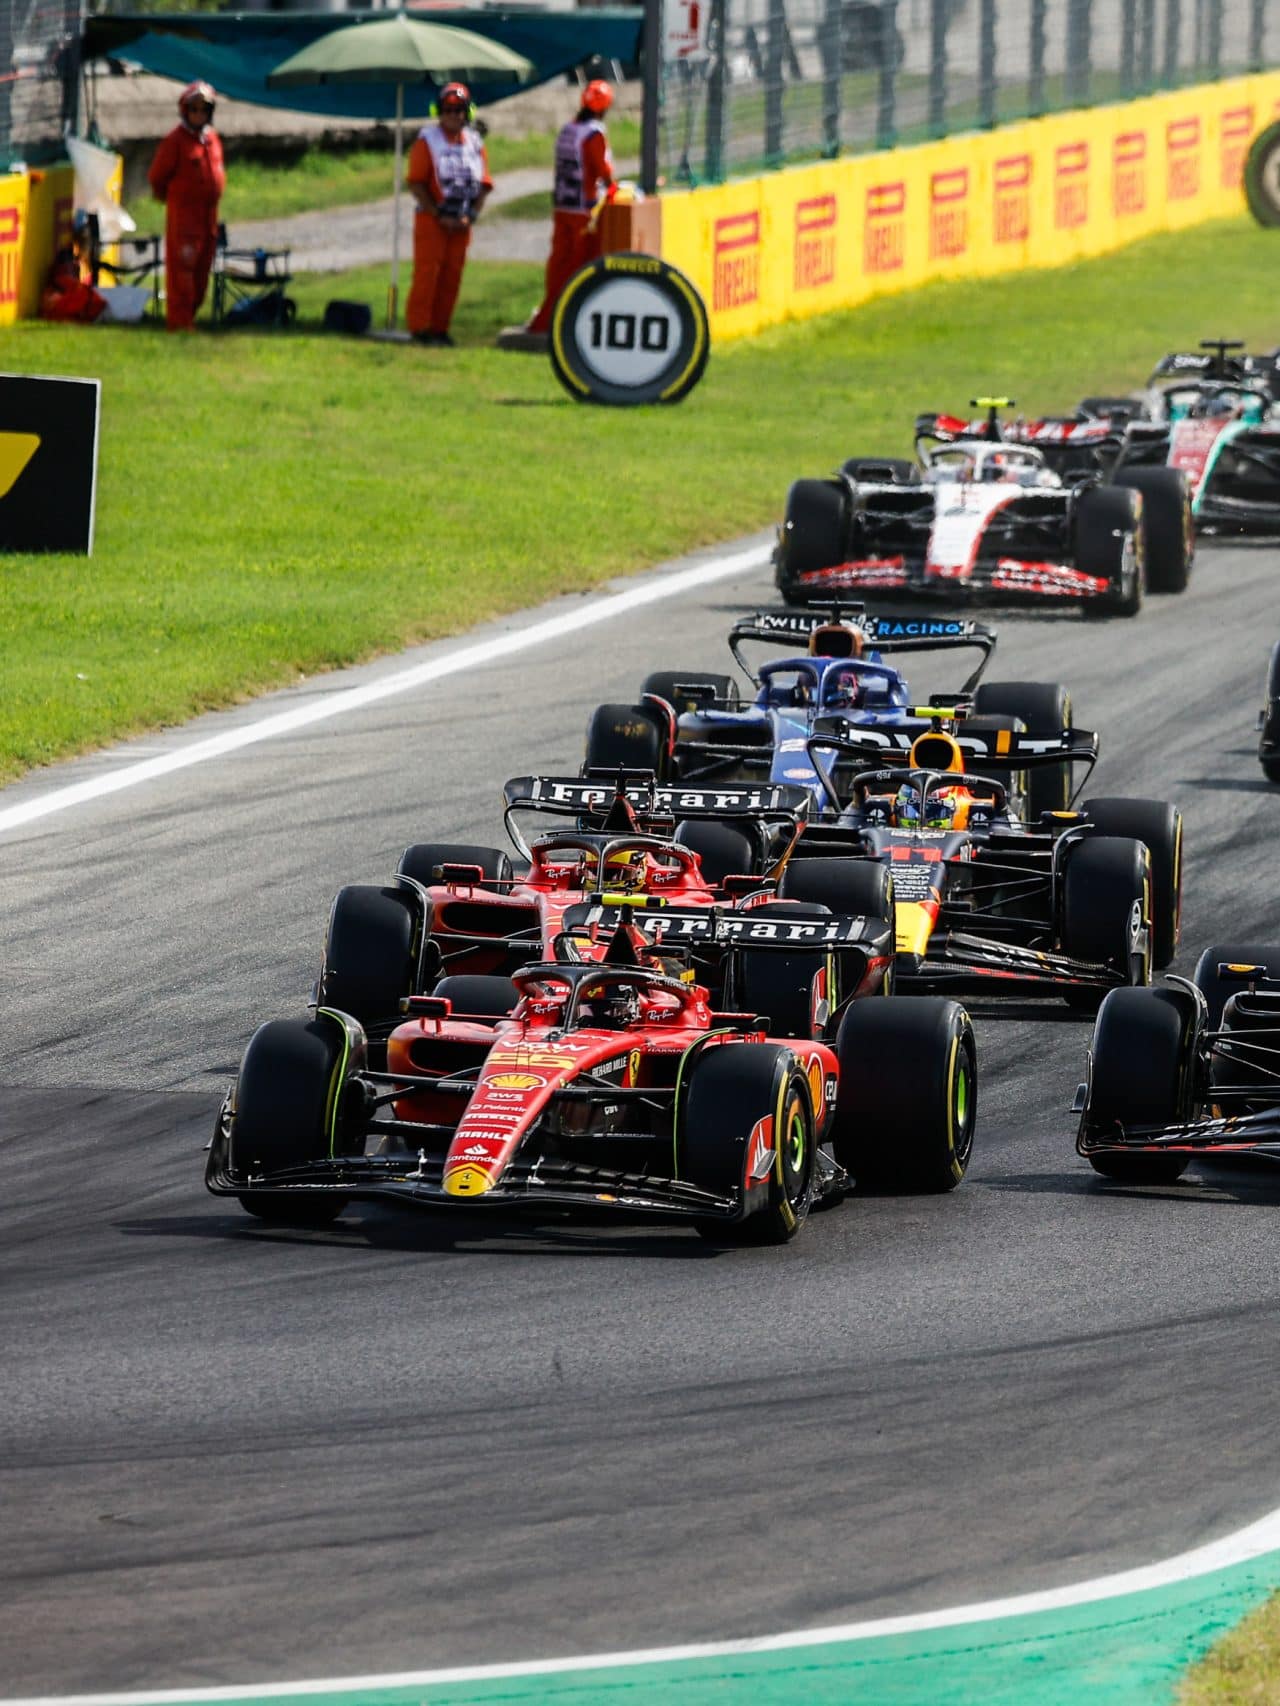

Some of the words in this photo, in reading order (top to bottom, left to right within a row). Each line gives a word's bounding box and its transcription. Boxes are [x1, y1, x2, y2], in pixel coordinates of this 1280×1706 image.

[712, 209, 760, 312] PIRELLI
[591, 312, 669, 353] 100
[877, 621, 959, 635] RACING
[880, 846, 943, 862] 11
[531, 1003, 560, 1014] Ray-Ban
[647, 1008, 675, 1021] Ray-Ban
[488, 1052, 577, 1071] 55
